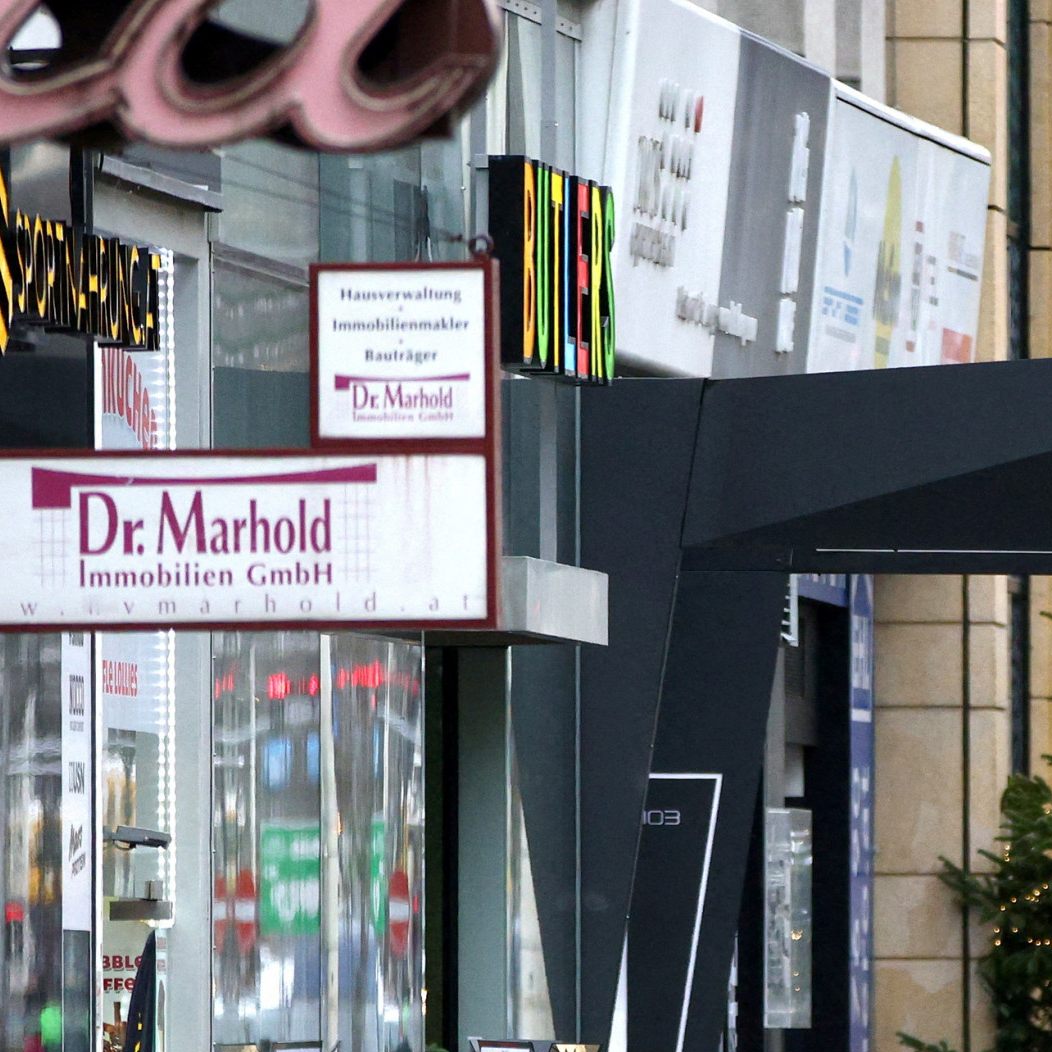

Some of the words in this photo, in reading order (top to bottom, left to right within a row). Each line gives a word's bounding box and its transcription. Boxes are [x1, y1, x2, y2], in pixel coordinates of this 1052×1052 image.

[523, 160, 616, 384] BUTLERS
[340, 286, 462, 302] Hausverwaltung
[333, 317, 469, 332] Immobilienmakler
[365, 349, 438, 364] Bauträger
[353, 384, 379, 410] Dr.
[384, 383, 453, 408] Marhold
[353, 411, 414, 422] Immobilien
[419, 411, 453, 421] GmbH
[79, 491, 145, 555] Dr.
[157, 490, 332, 554] Marhold
[80, 560, 233, 588] Immobilien
[247, 562, 333, 586] GmbH
[643, 810, 681, 826] 103
